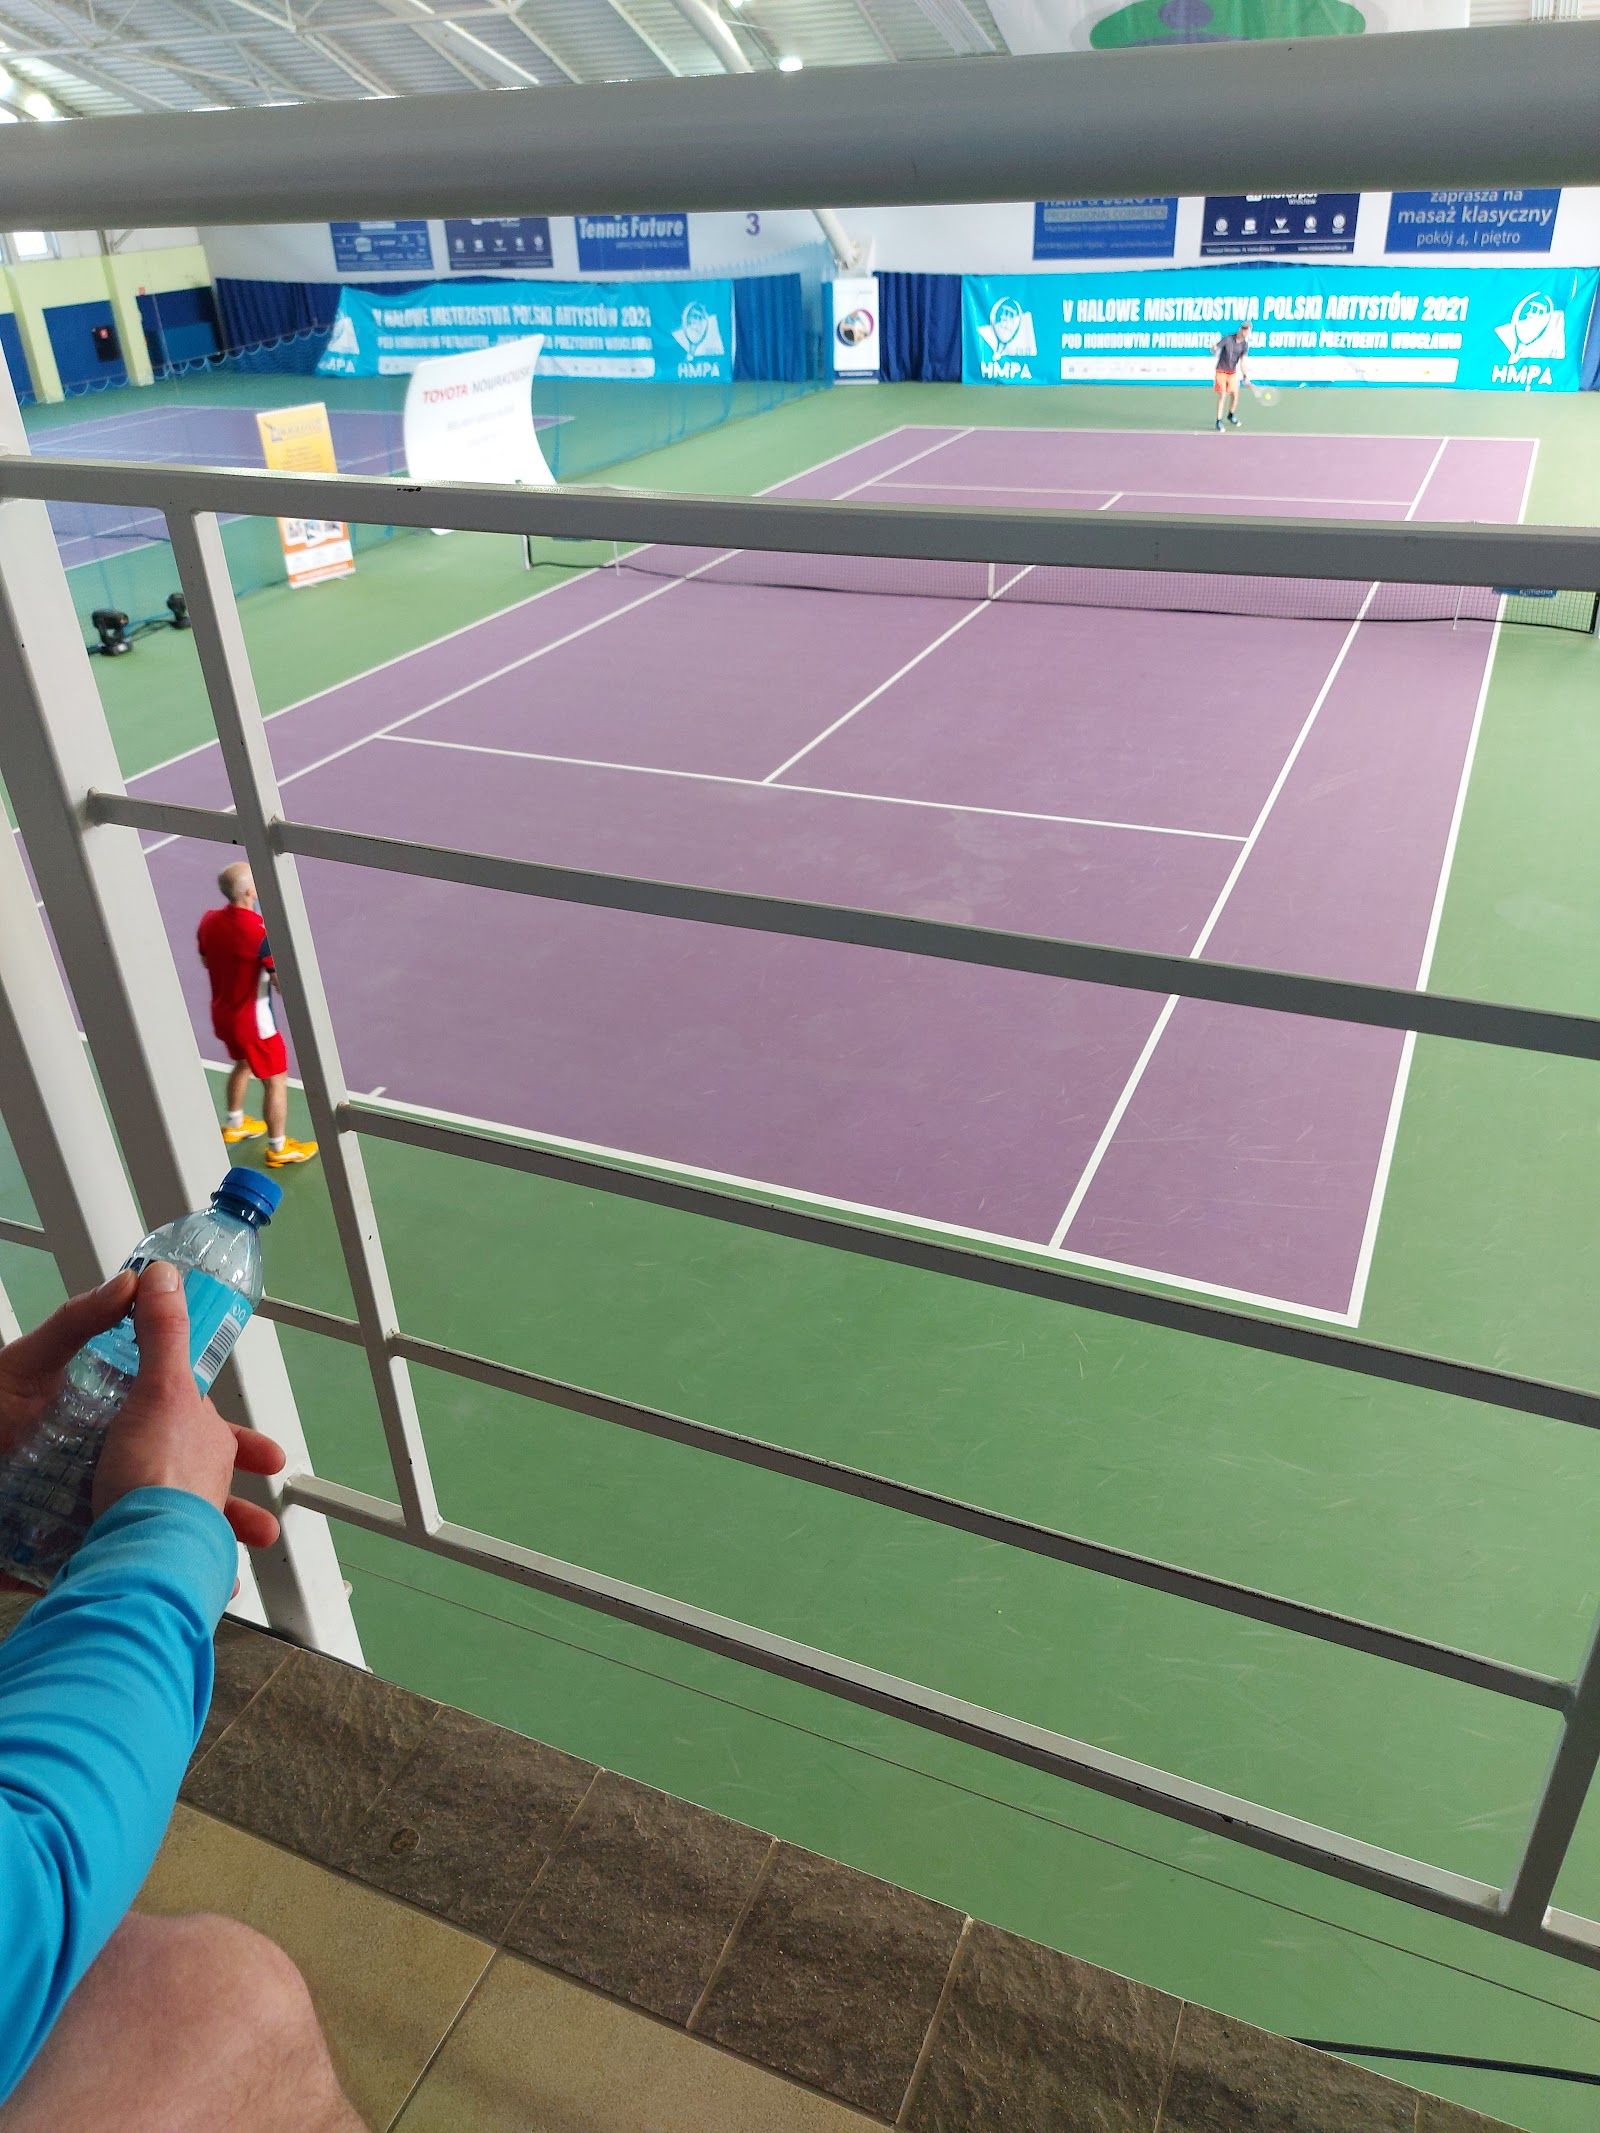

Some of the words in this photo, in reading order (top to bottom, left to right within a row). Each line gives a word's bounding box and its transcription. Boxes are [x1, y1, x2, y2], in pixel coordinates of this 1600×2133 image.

[1430, 190, 1498, 205] zaprasza
[1503, 190, 1523, 202] na
[746, 212, 760, 236] 3
[1398, 206, 1457, 224] masaż
[1462, 205, 1553, 227] klasyczny
[578, 215, 628, 239] Tennis
[631, 215, 684, 238] Future
[1416, 230, 1453, 247] pokój
[1481, 230, 1521, 246] piętro
[1063, 298, 1075, 323] V
[1077, 298, 1140, 323] HALOWE
[1144, 296, 1260, 322] MISTRZOSTWA
[1263, 295, 1323, 320] POLSKI
[1325, 290, 1420, 321] ARTYSTÓW
[1421, 295, 1470, 321] 2021
[677, 362, 720, 379] HMPA
[980, 361, 1032, 379] HMPA
[1491, 364, 1553, 385] HMPA
[423, 384, 469, 404] TOYOTA
